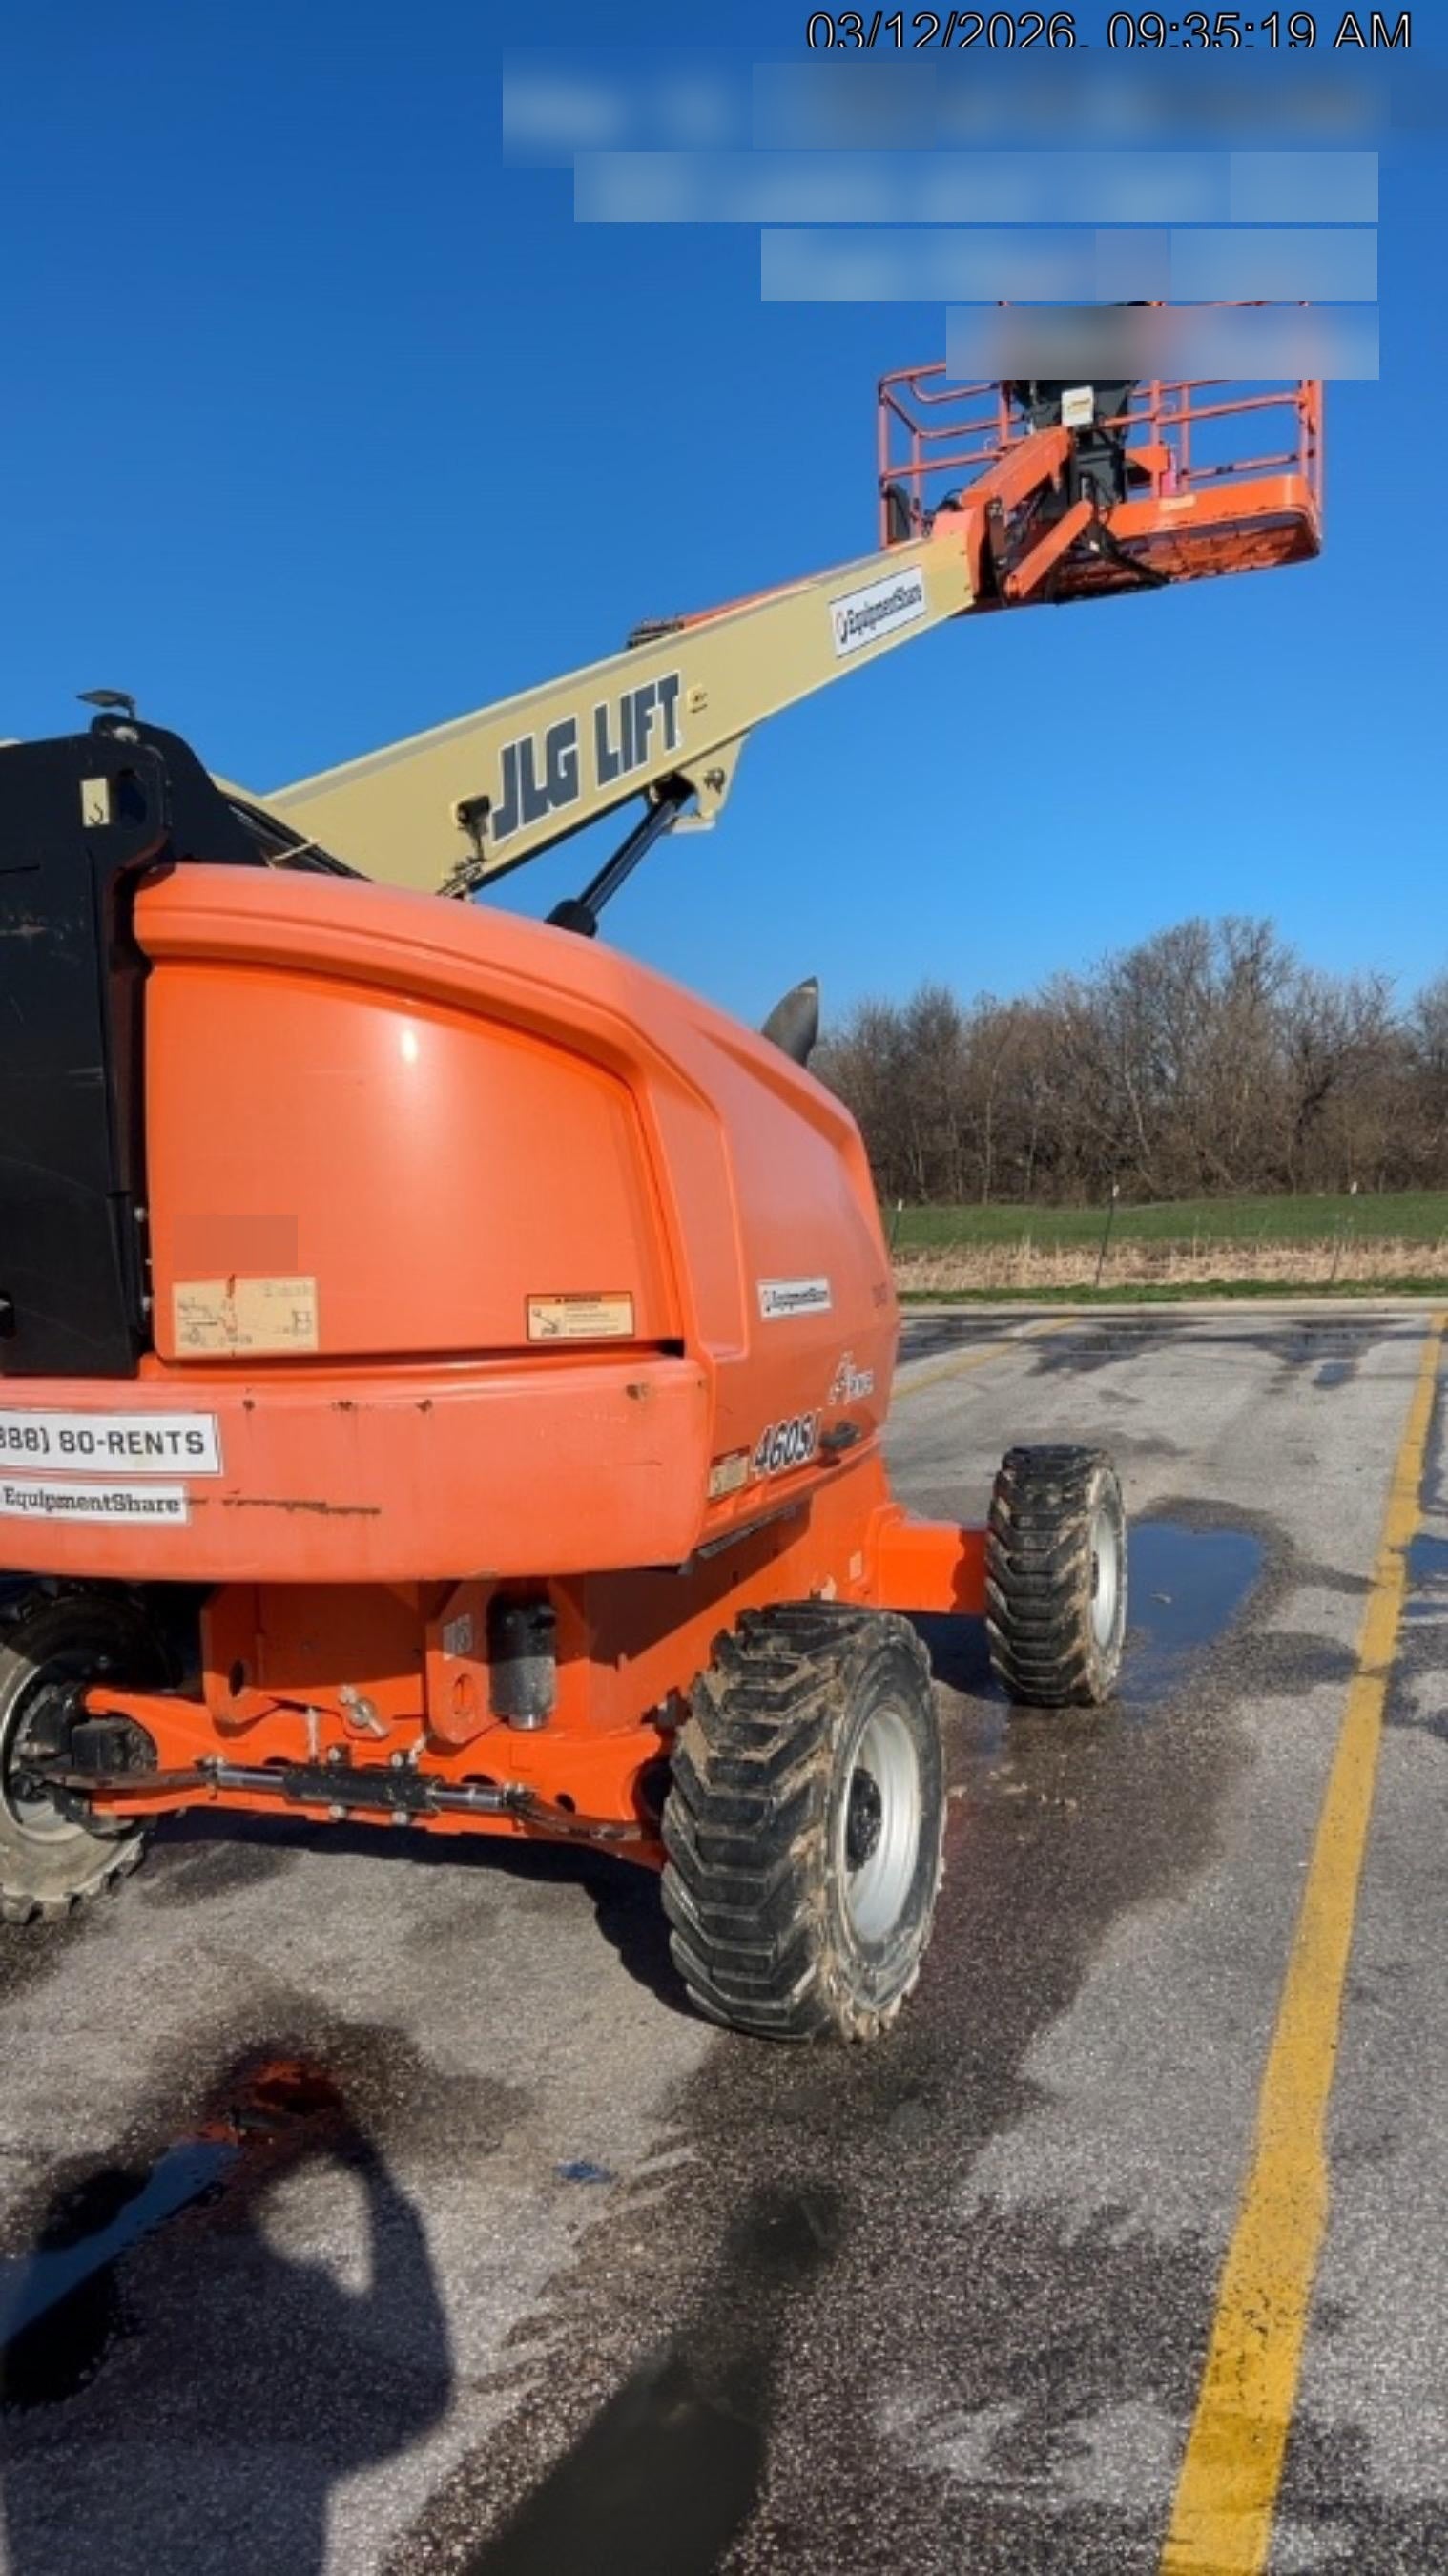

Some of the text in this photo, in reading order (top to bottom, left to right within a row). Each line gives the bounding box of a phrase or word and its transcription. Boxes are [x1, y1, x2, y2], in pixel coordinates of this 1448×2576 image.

[489, 671, 681, 843] JLG LIFT
[59, 1430, 204, 1455] 80-RENTS
[3, 1485, 181, 1513] EquipmentShare
